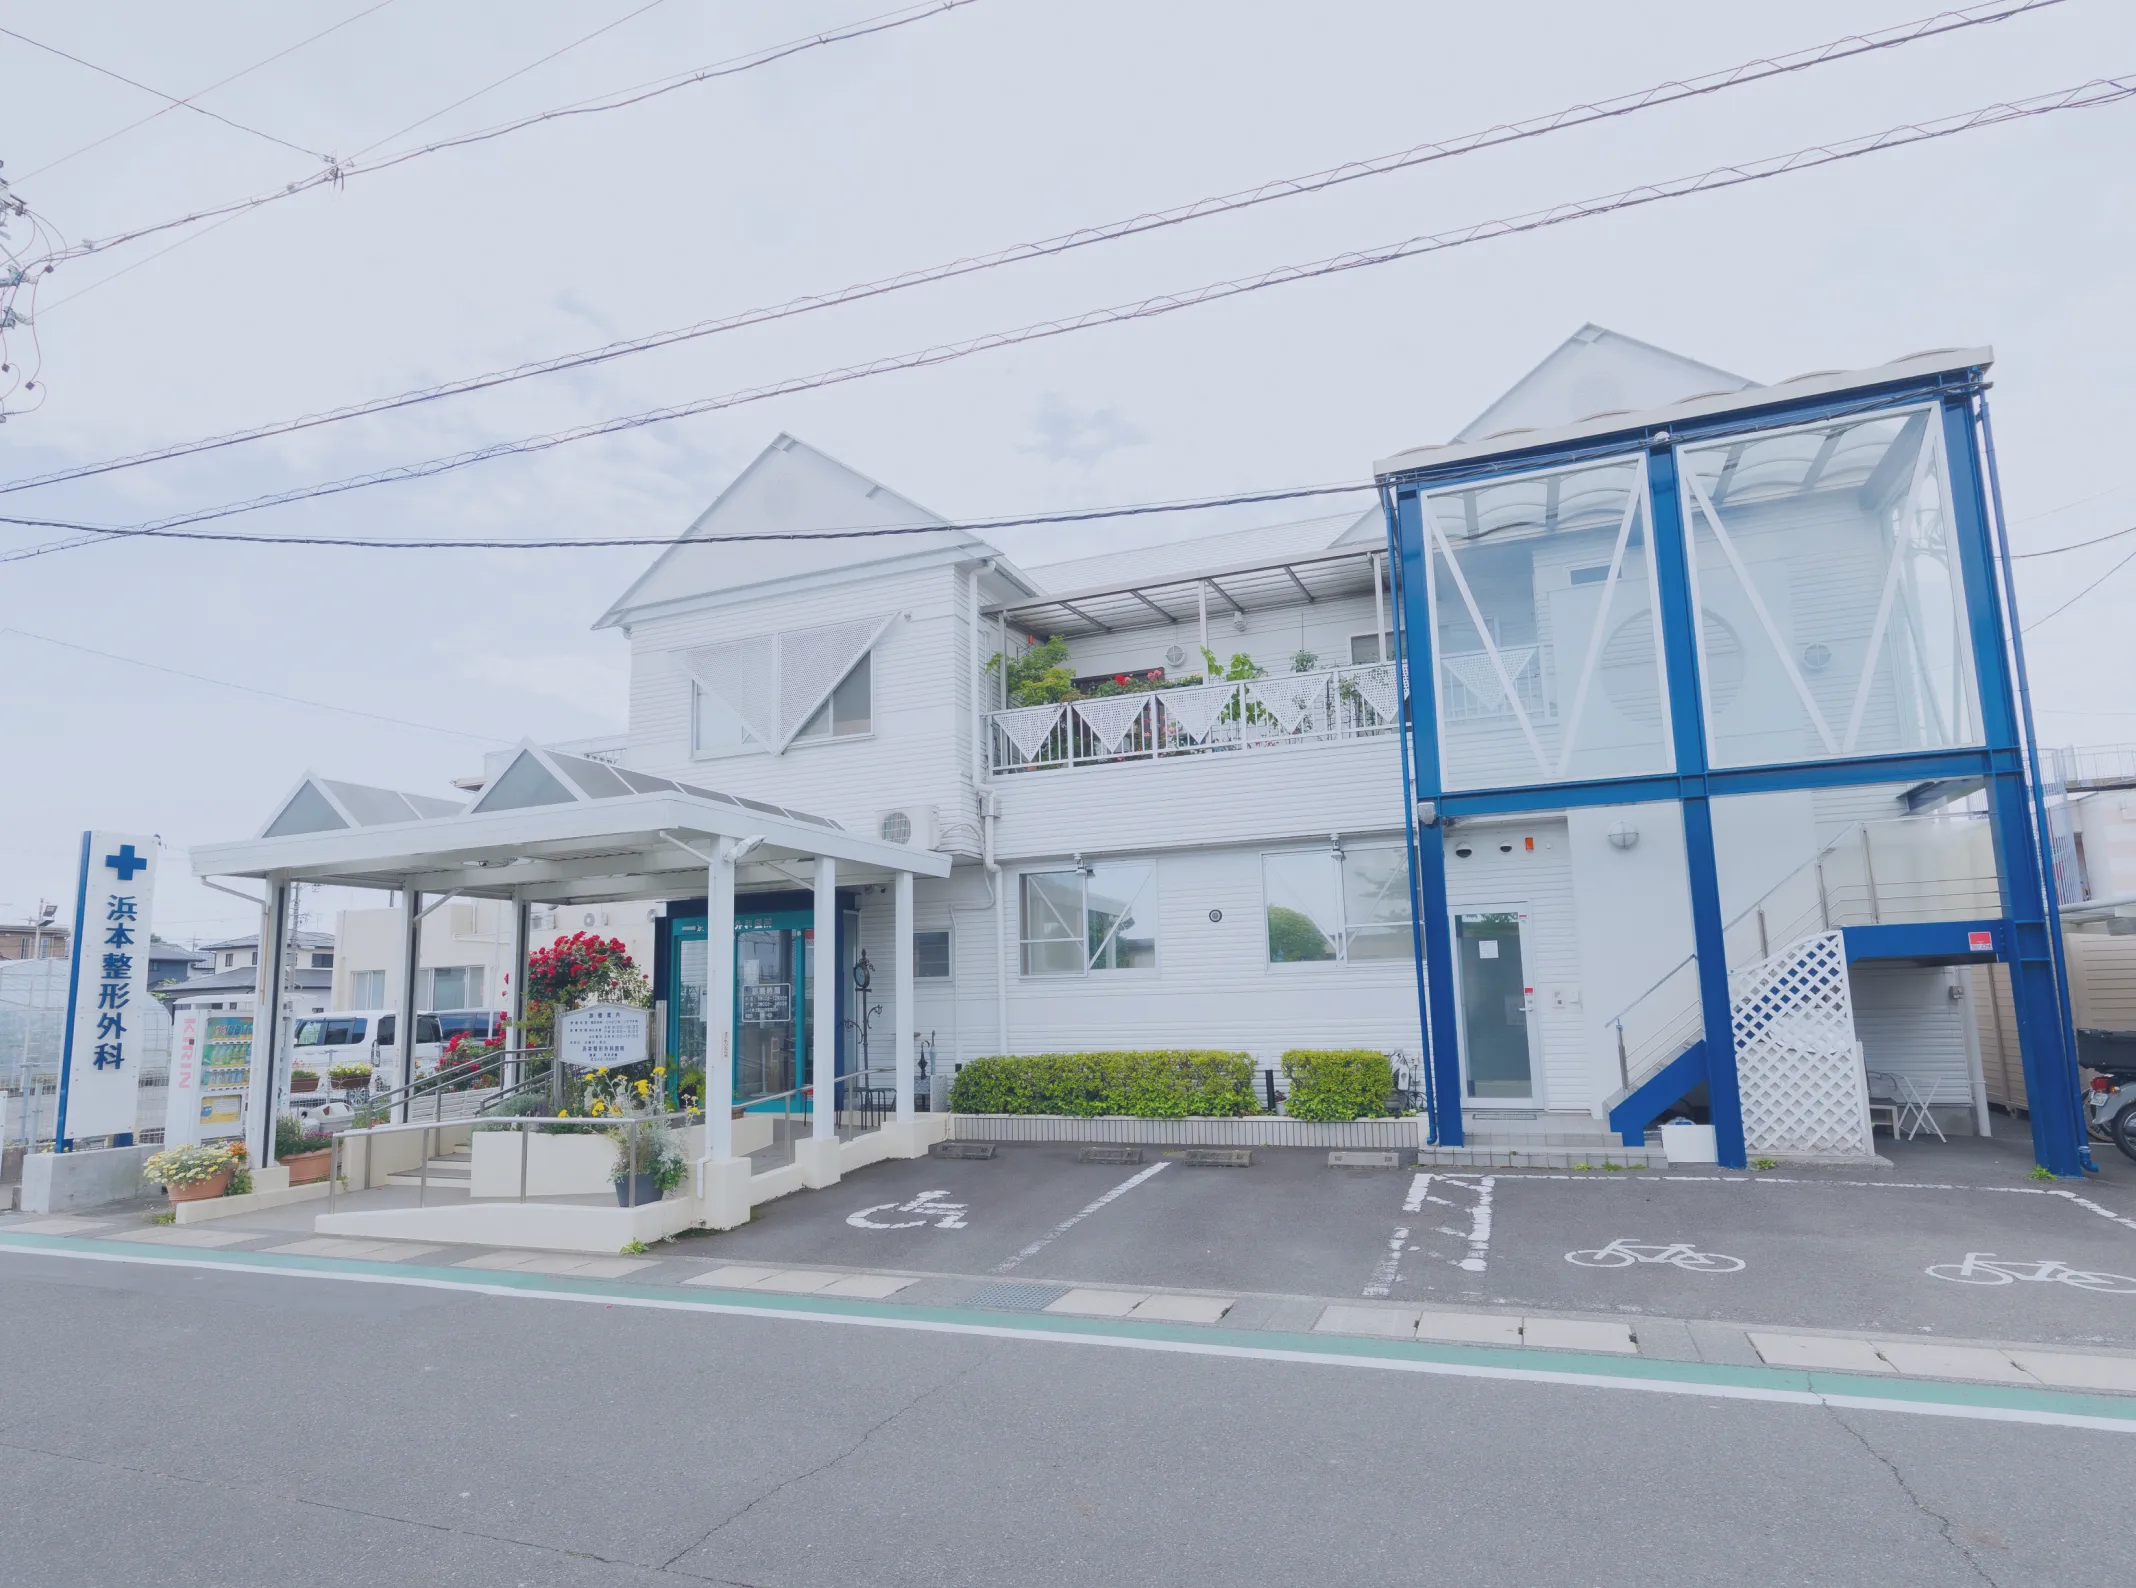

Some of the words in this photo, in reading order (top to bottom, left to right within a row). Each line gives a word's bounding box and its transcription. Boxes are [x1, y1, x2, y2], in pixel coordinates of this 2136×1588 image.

[92, 894, 138, 1071] 浜本整形外科
[178, 1018, 197, 1089] KIRIN
